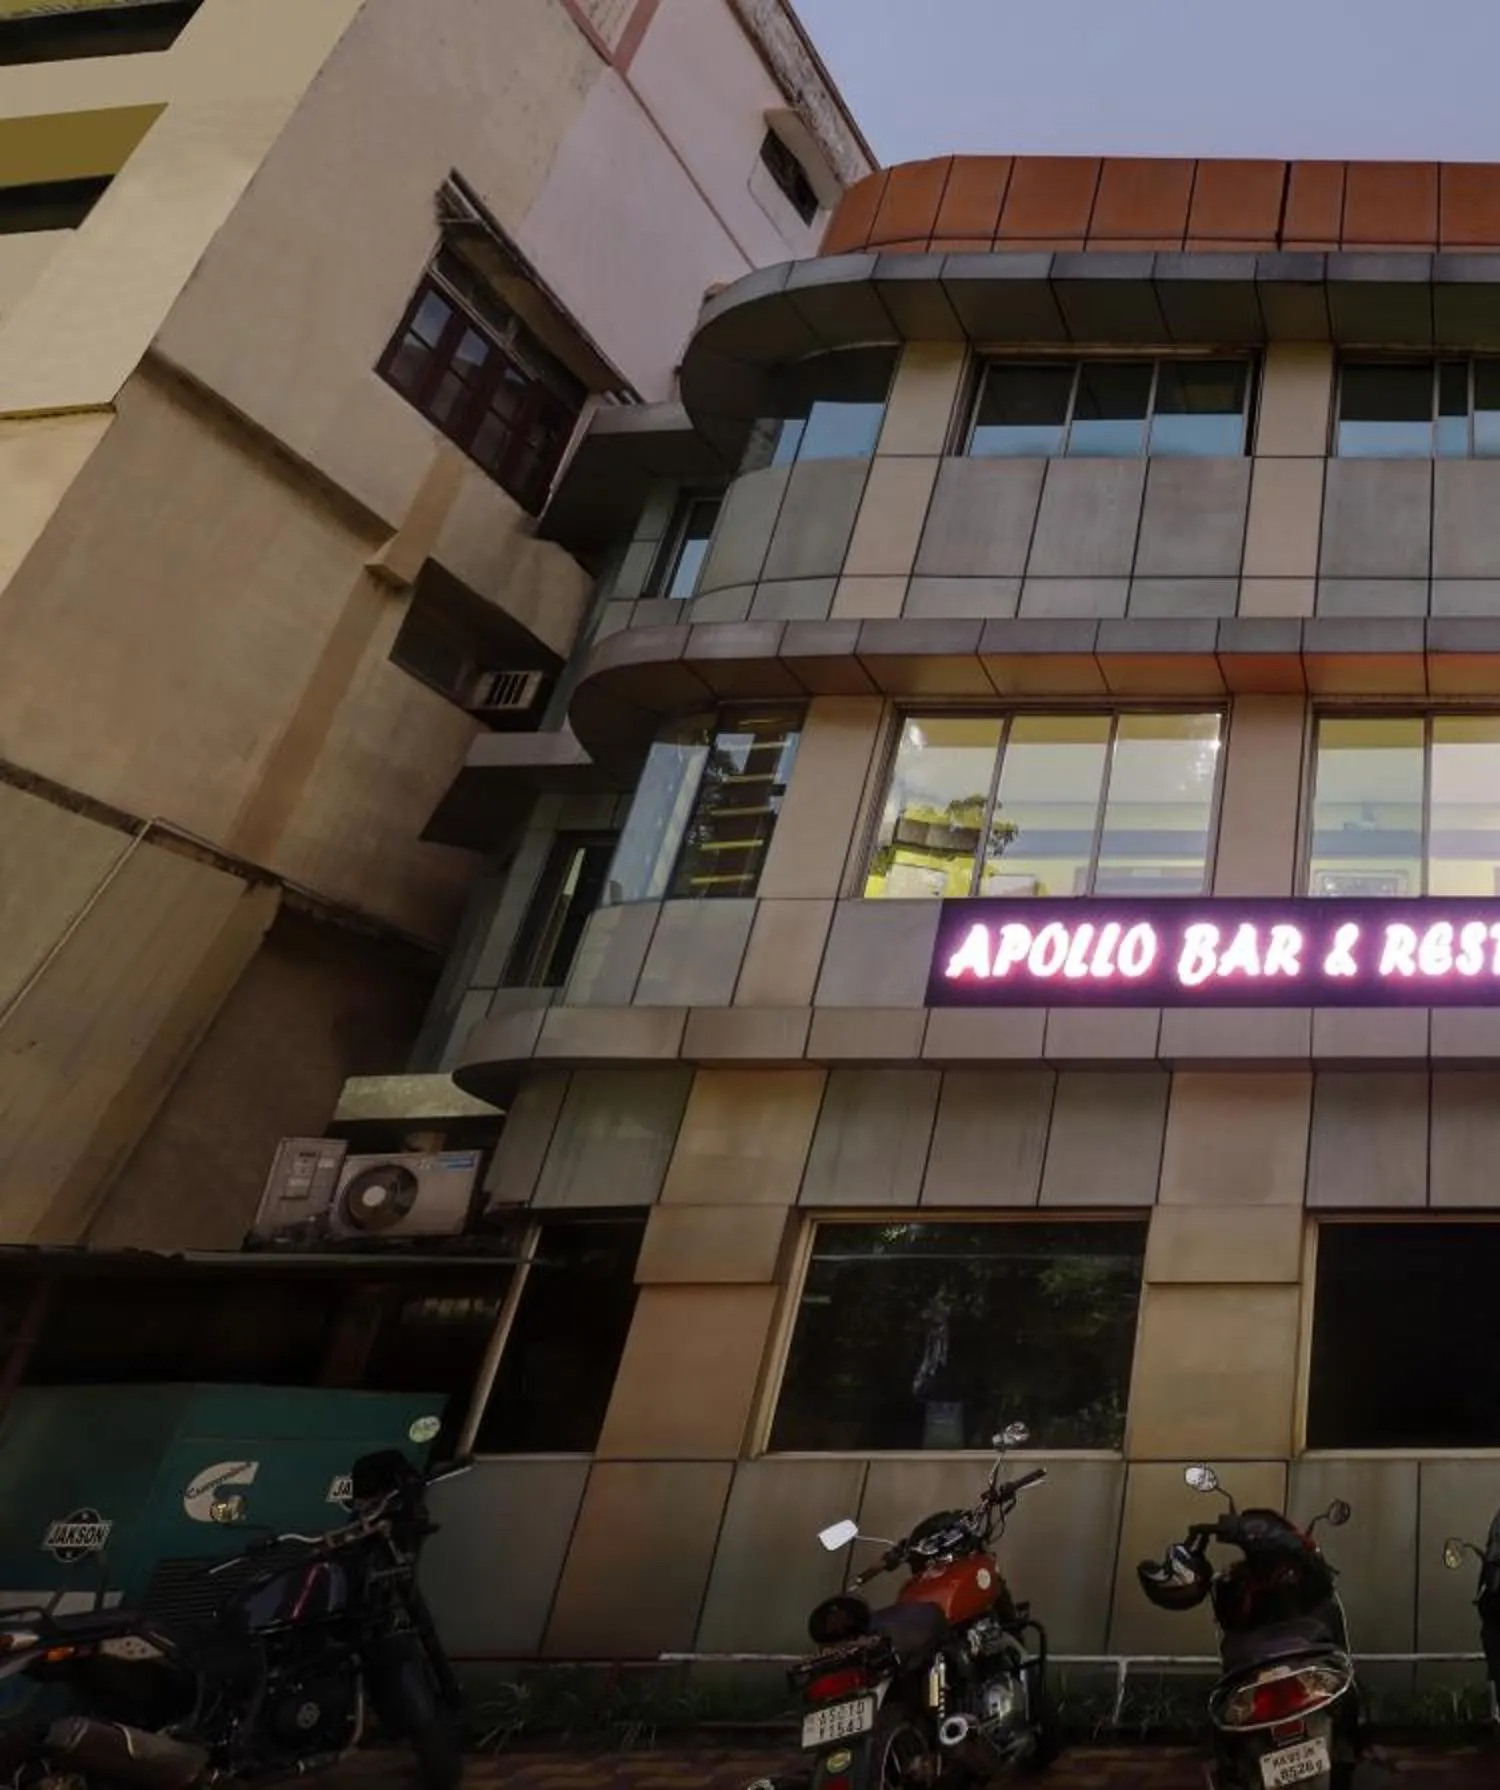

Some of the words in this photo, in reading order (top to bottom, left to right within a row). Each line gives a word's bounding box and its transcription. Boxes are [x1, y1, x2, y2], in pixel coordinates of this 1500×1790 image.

[945, 919, 1159, 980] APOLLO
[1176, 921, 1303, 986] BAR
[1322, 922, 1361, 979] &
